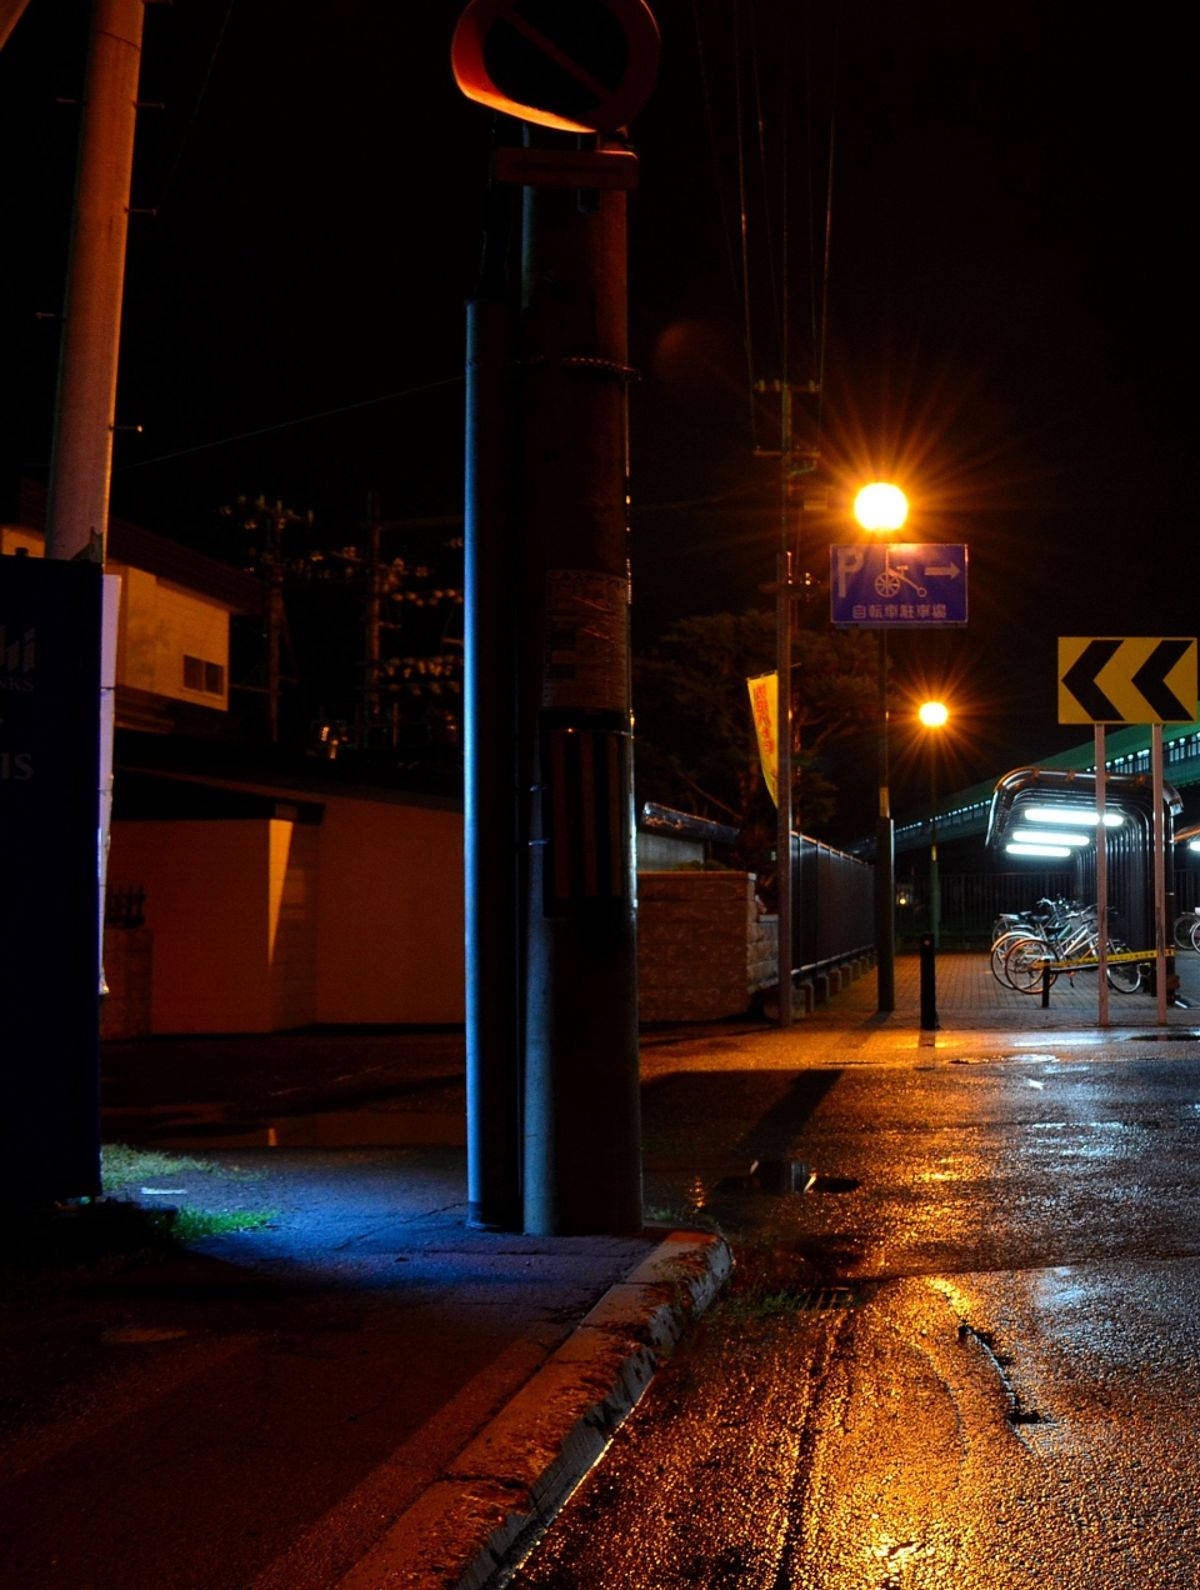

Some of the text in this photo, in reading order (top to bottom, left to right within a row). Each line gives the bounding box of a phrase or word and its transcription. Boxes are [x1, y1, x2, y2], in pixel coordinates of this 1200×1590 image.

[837, 547, 864, 599] P
[852, 603, 947, 620] 自転車駐車場
